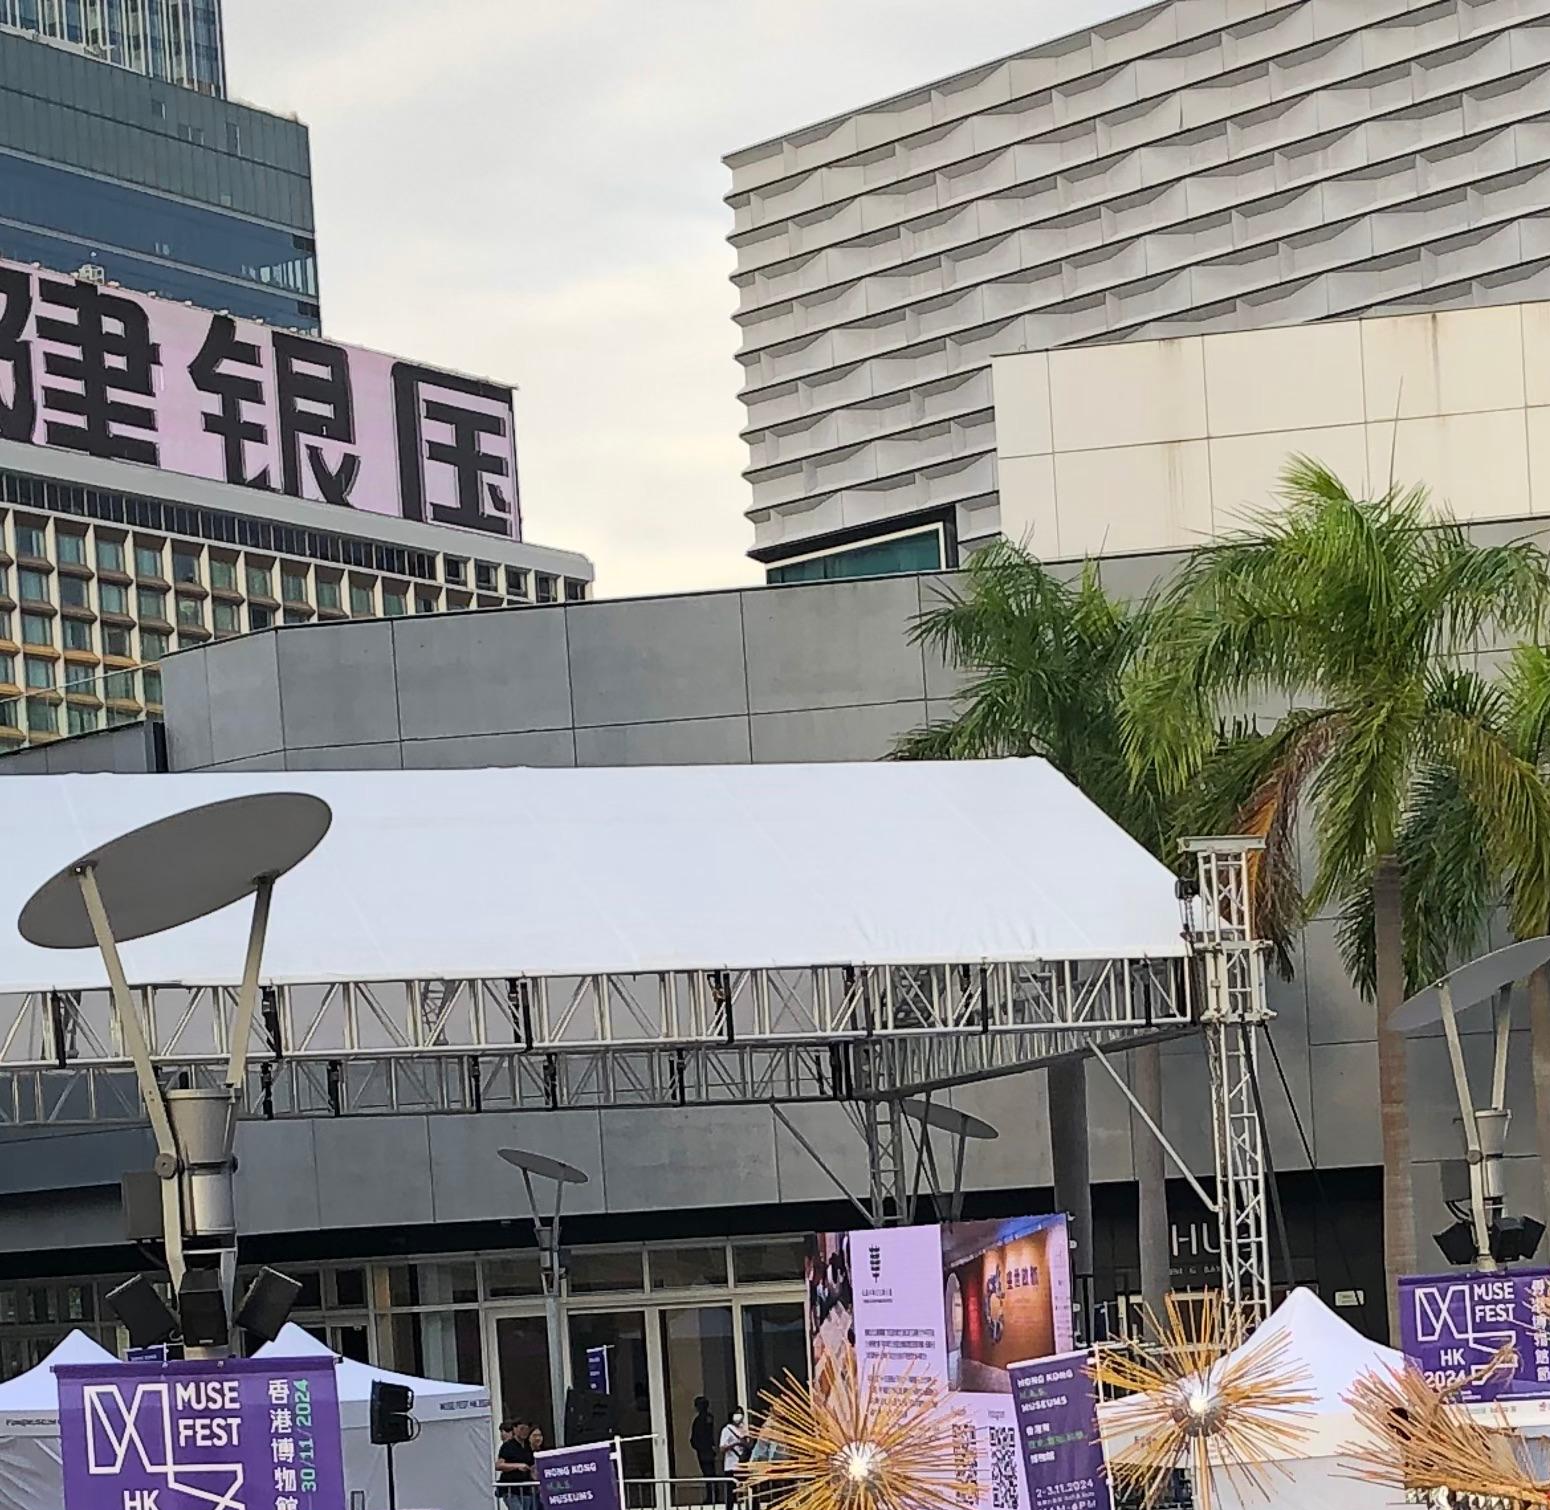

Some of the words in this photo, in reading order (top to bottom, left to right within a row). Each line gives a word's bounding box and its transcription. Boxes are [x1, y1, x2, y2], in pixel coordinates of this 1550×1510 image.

[1473, 1282, 1515, 1301] MUSE
[1475, 1304, 1516, 1322] FEST
[1440, 1349, 1466, 1366] HK
[175, 1381, 241, 1411] MUSE
[177, 1416, 242, 1447] FEST
